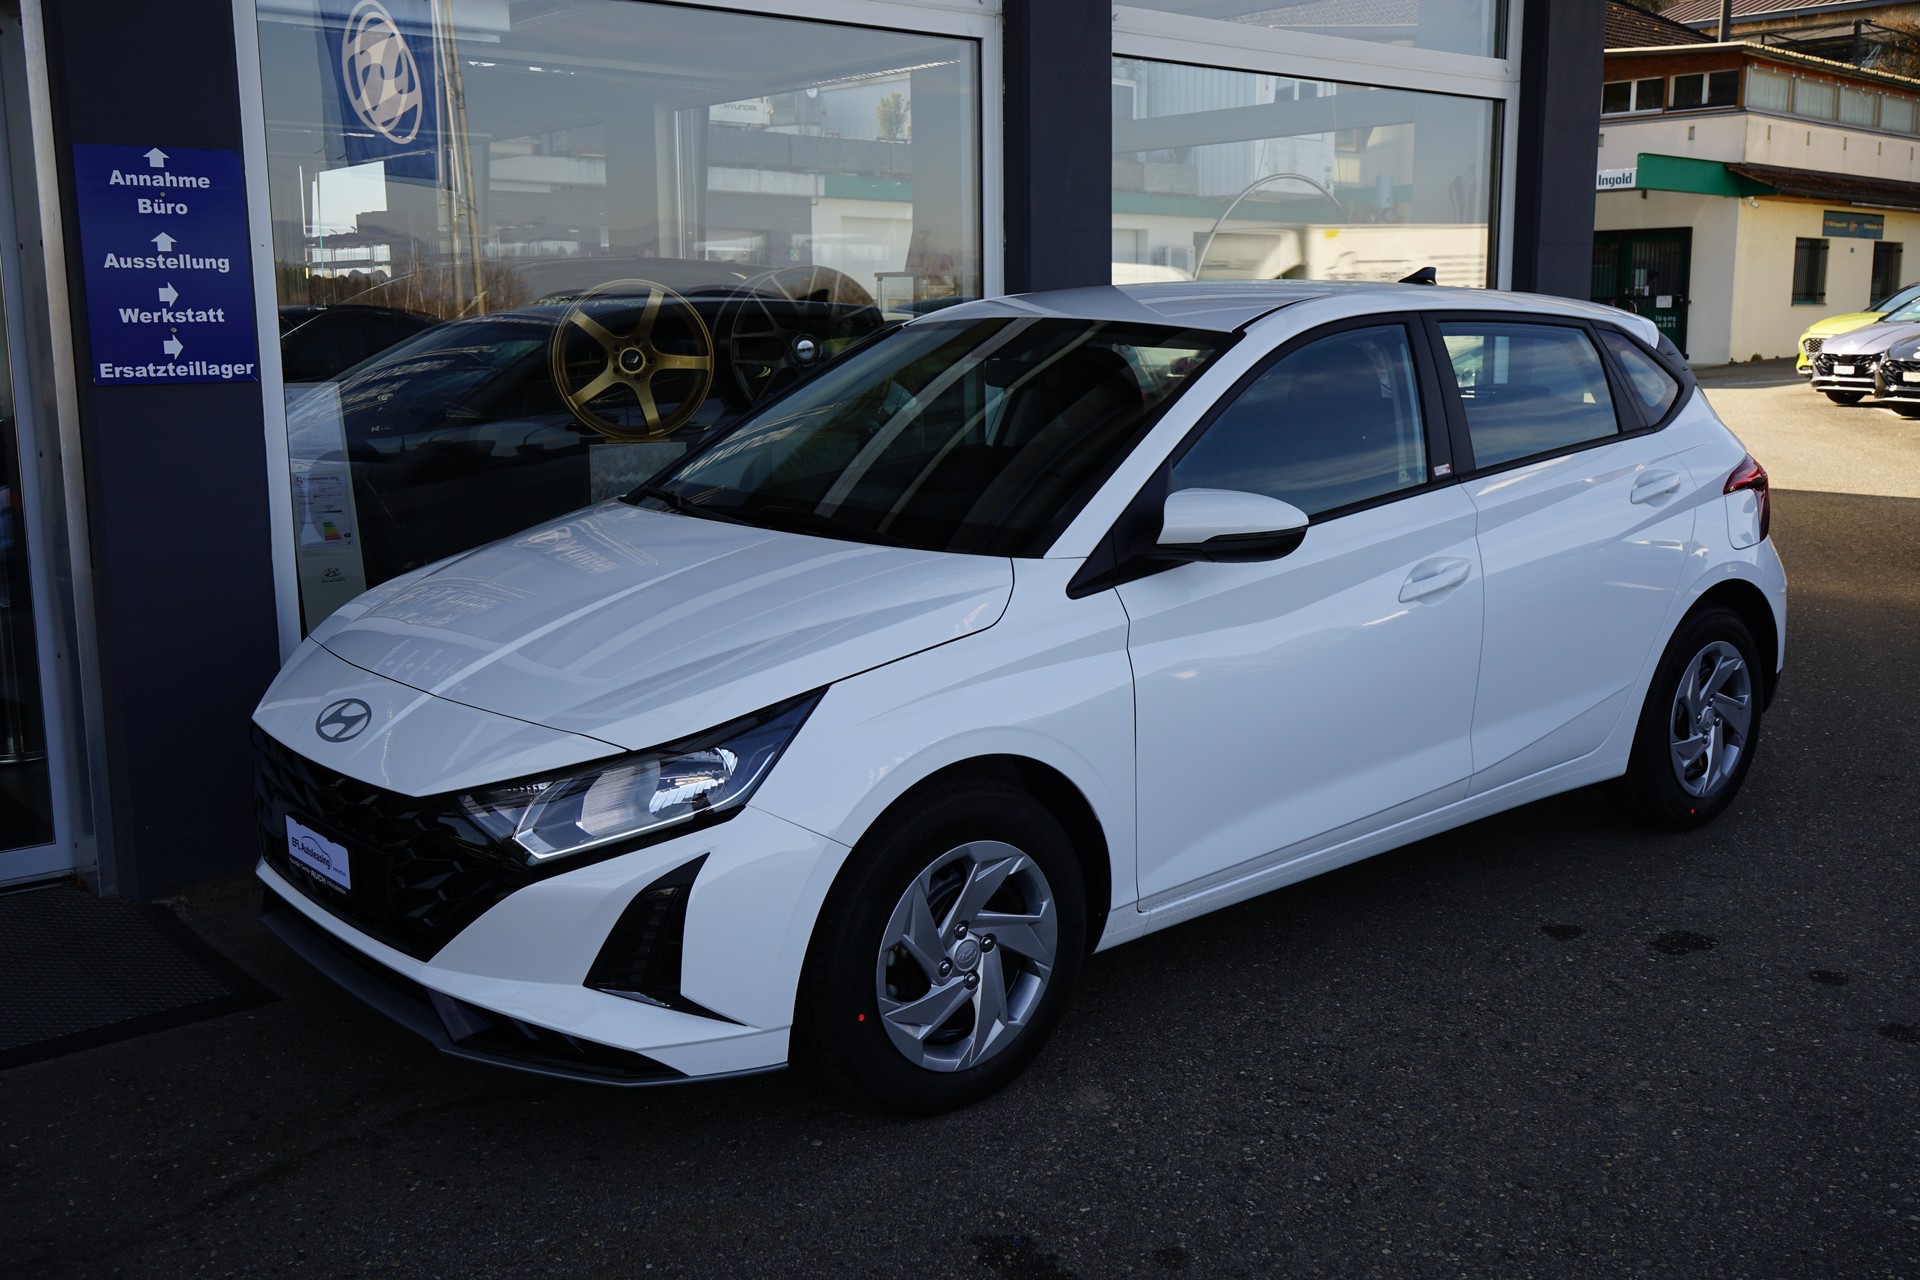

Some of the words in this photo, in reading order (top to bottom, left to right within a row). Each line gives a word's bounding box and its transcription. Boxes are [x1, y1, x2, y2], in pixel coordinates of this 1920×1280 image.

[109, 170, 211, 189] Annahme
[1598, 172, 1633, 187] Ingold
[137, 198, 188, 215] Büro
[103, 253, 230, 273] Ausstellung
[119, 307, 225, 324] Werkstatt
[99, 361, 255, 381] Ersatzteillager
